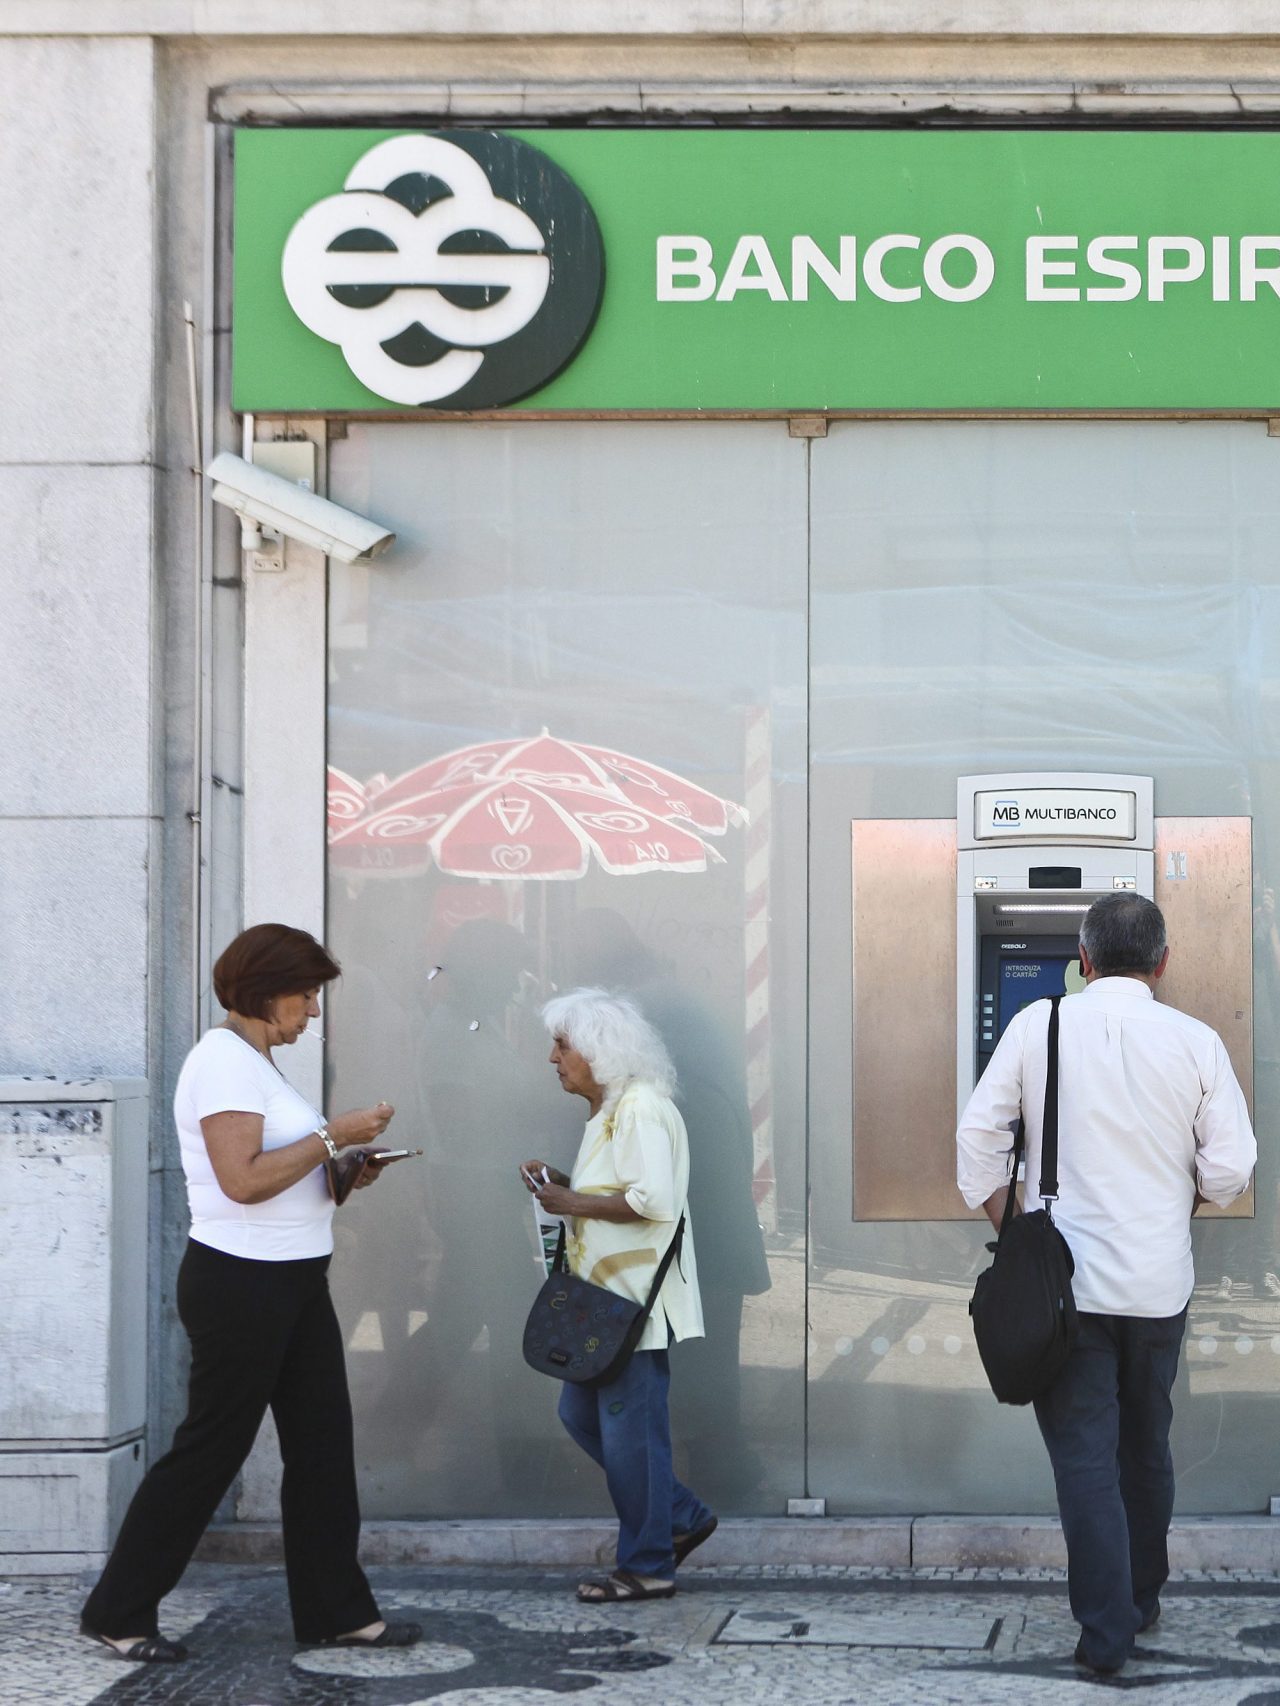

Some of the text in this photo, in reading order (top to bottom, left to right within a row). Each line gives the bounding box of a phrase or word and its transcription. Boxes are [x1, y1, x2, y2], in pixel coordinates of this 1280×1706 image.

[655, 233, 995, 303] BANCO
[993, 806, 1117, 821] MB MULTIBANCO
[1012, 970, 1038, 978] CARTÃO
